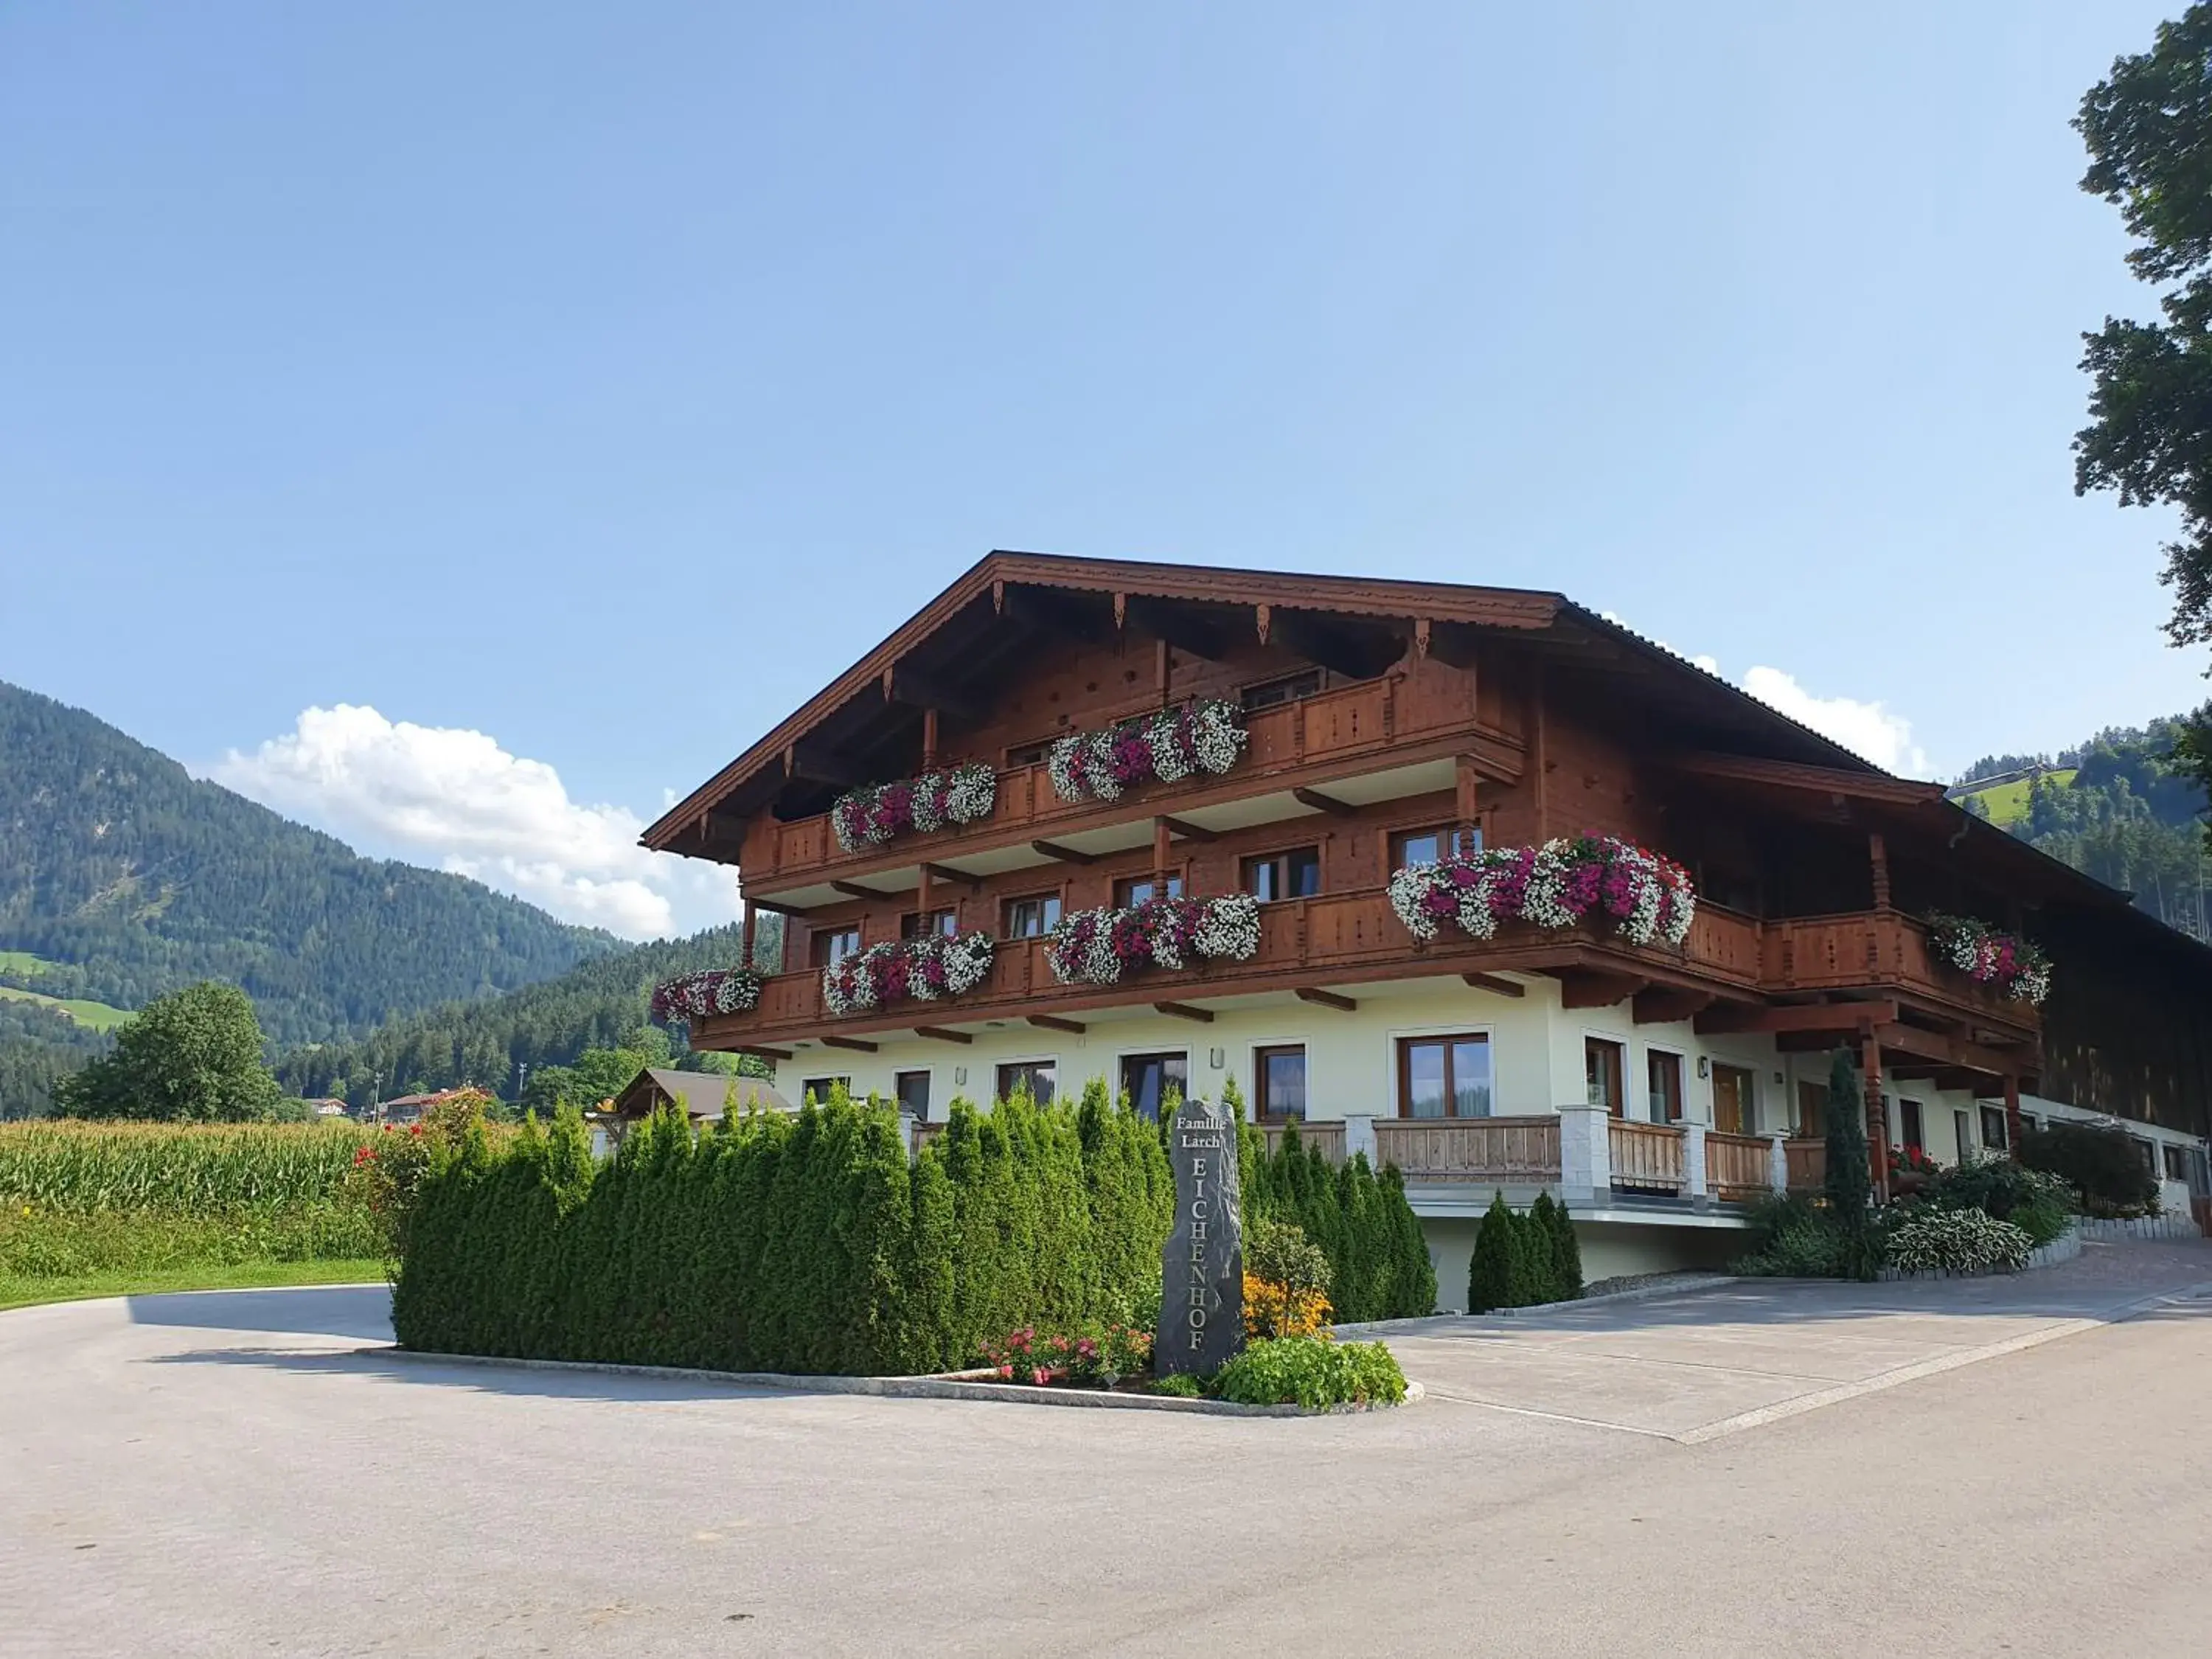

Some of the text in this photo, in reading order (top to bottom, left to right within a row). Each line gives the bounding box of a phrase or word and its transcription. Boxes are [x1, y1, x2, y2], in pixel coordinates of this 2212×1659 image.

[1177, 1117, 1226, 1130] Familie
[1182, 1135, 1220, 1148] Larch
[1189, 1158, 1207, 1350] EICHENHOF
